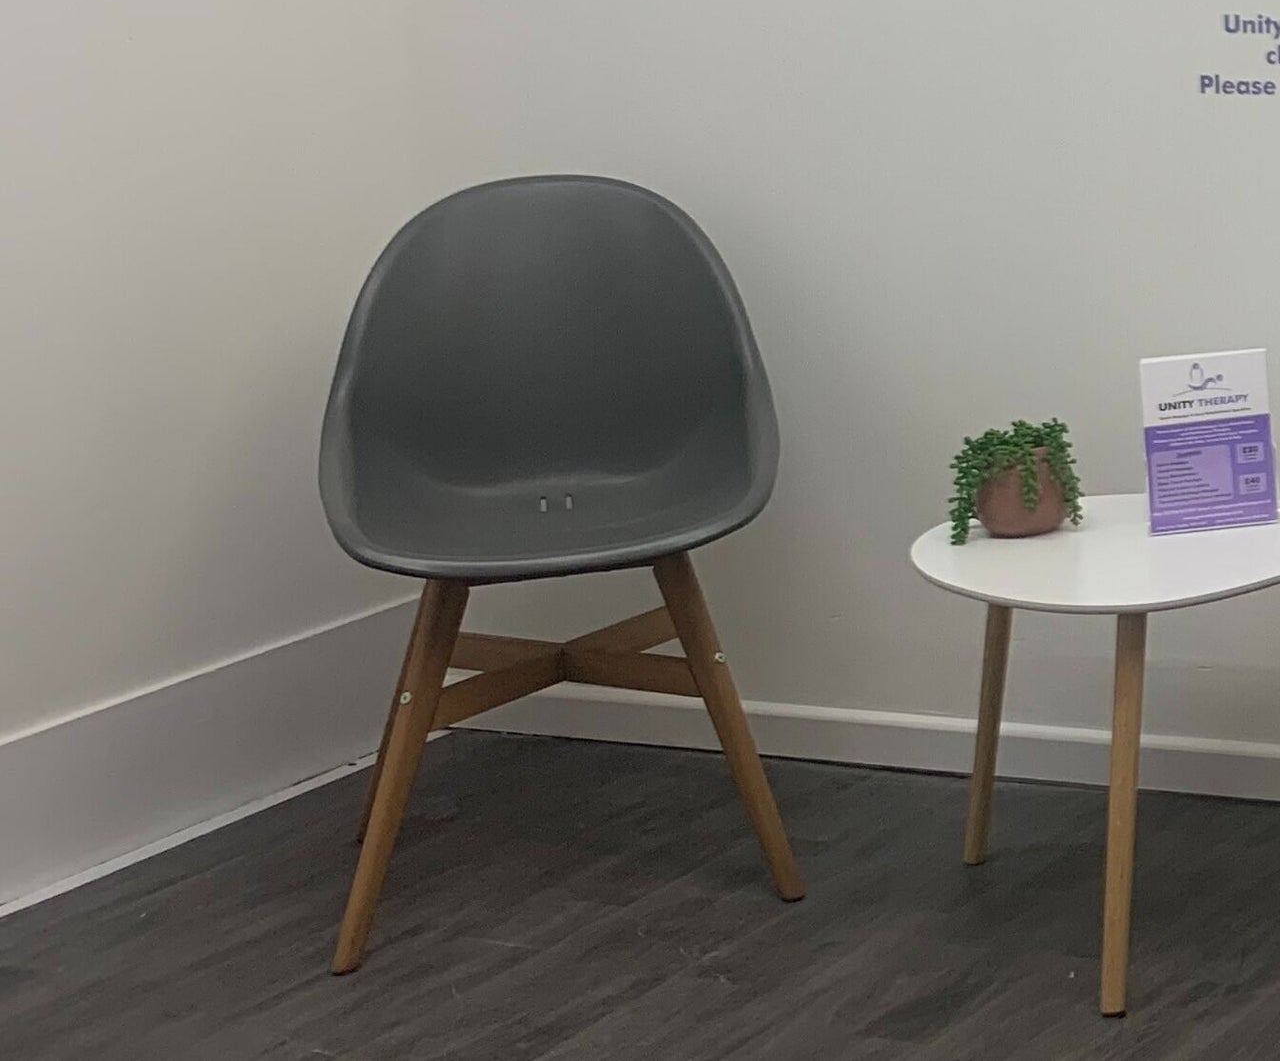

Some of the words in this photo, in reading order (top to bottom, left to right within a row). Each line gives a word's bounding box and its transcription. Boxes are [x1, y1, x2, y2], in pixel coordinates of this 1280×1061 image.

[1199, 75, 1276, 95] Please
[1159, 400, 1195, 411] UNITY
[1197, 394, 1249, 407] THERAPY
